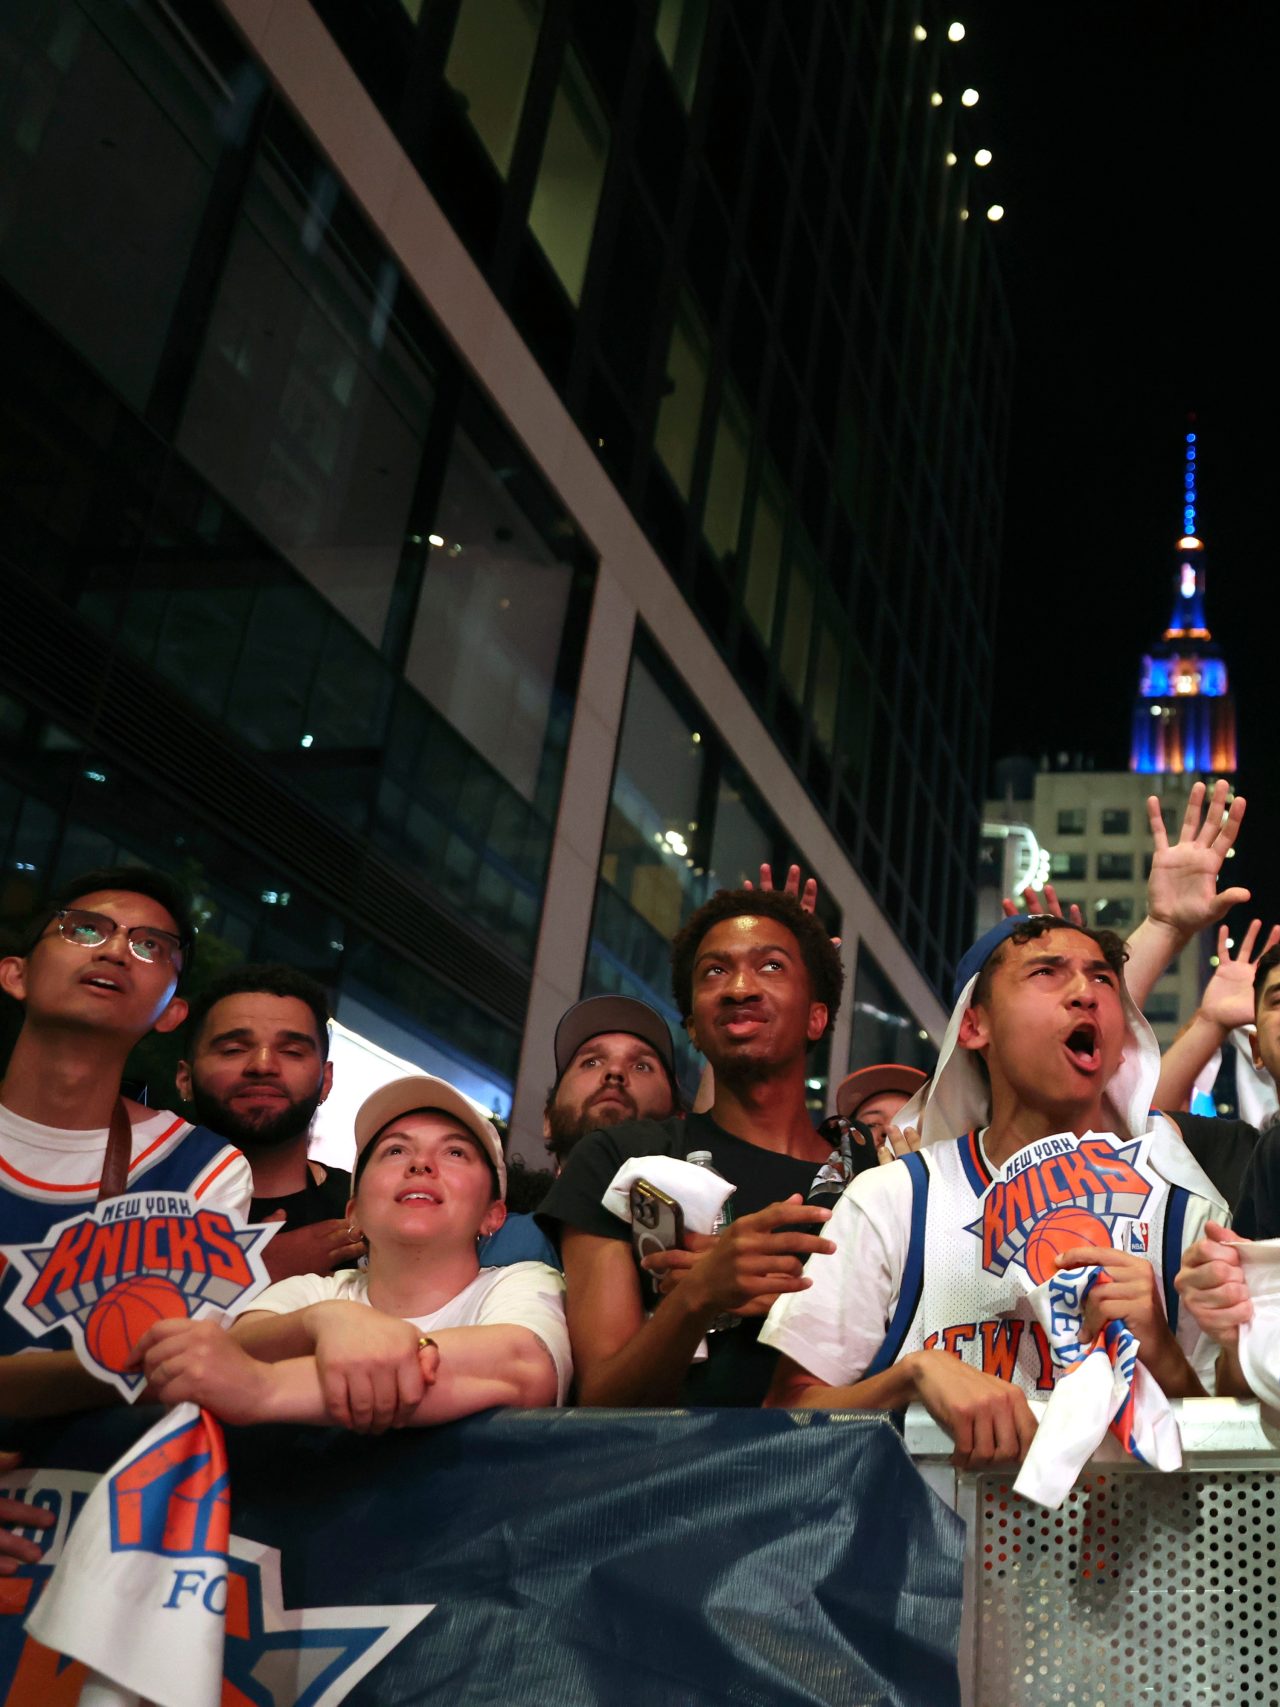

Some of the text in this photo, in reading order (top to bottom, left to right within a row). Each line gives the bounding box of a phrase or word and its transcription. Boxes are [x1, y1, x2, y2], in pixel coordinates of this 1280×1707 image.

[1005, 1137, 1075, 1181] NEW YORK
[101, 1196, 193, 1223] NEW YORK
[983, 1140, 1152, 1269] KNICKS
[23, 1208, 256, 1309] KNICKS
